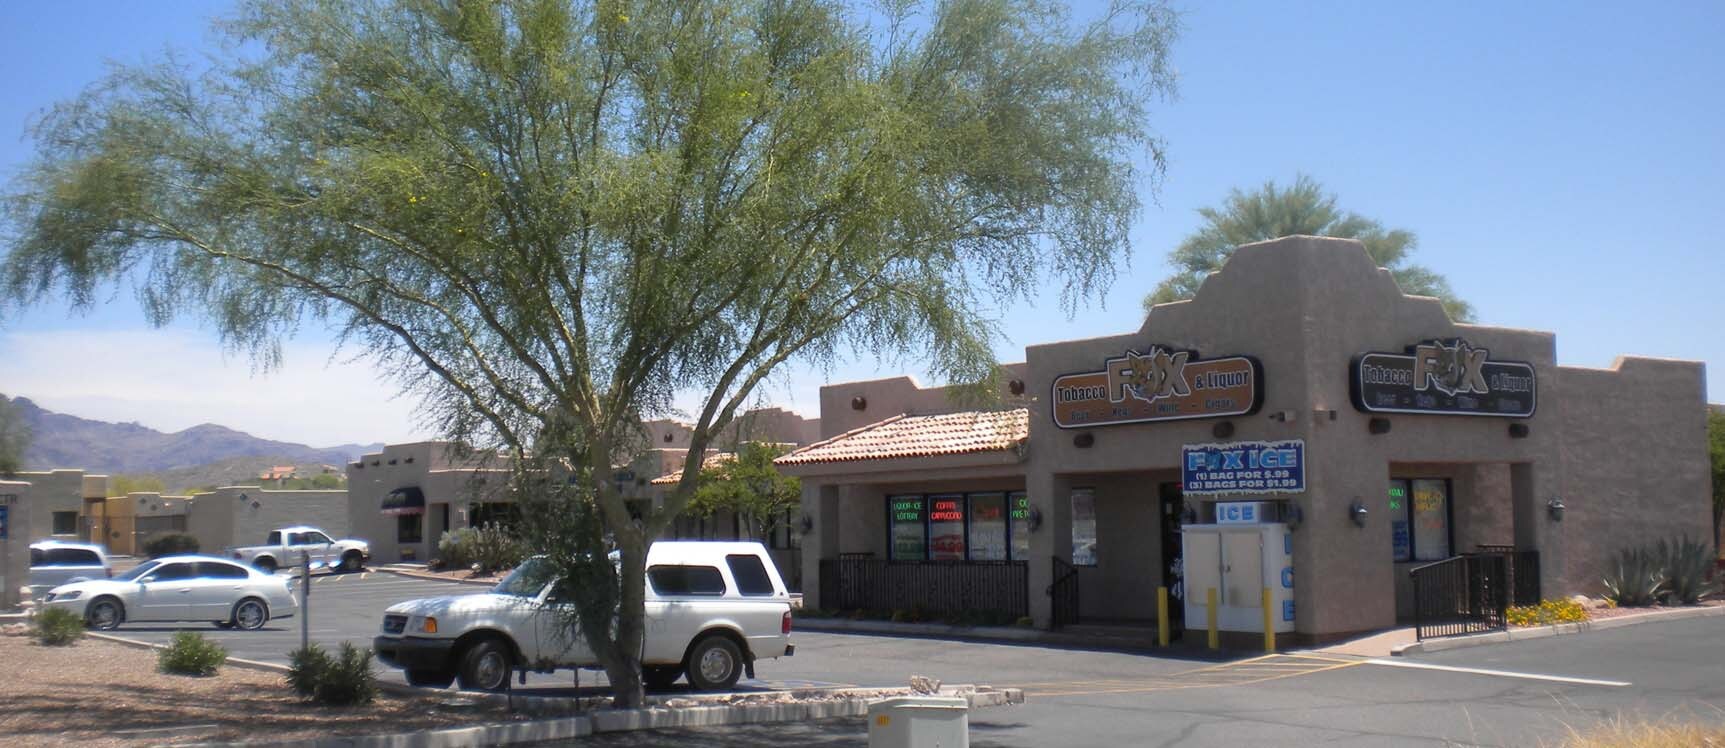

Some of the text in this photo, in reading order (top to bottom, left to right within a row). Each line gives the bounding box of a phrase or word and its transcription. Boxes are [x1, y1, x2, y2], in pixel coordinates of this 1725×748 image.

[1057, 351, 1249, 403] Tobacco FOX & Liquor
[1363, 364, 1412, 386] Tobacco
[1248, 448, 1297, 469] ICE
[1195, 470, 1290, 481] (1) BAG FOR $.99
[1204, 480, 1237, 489] BAGS
[1239, 480, 1265, 488] FOR
[1266, 479, 1297, 487] $1.99
[1219, 505, 1254, 521] ICE
